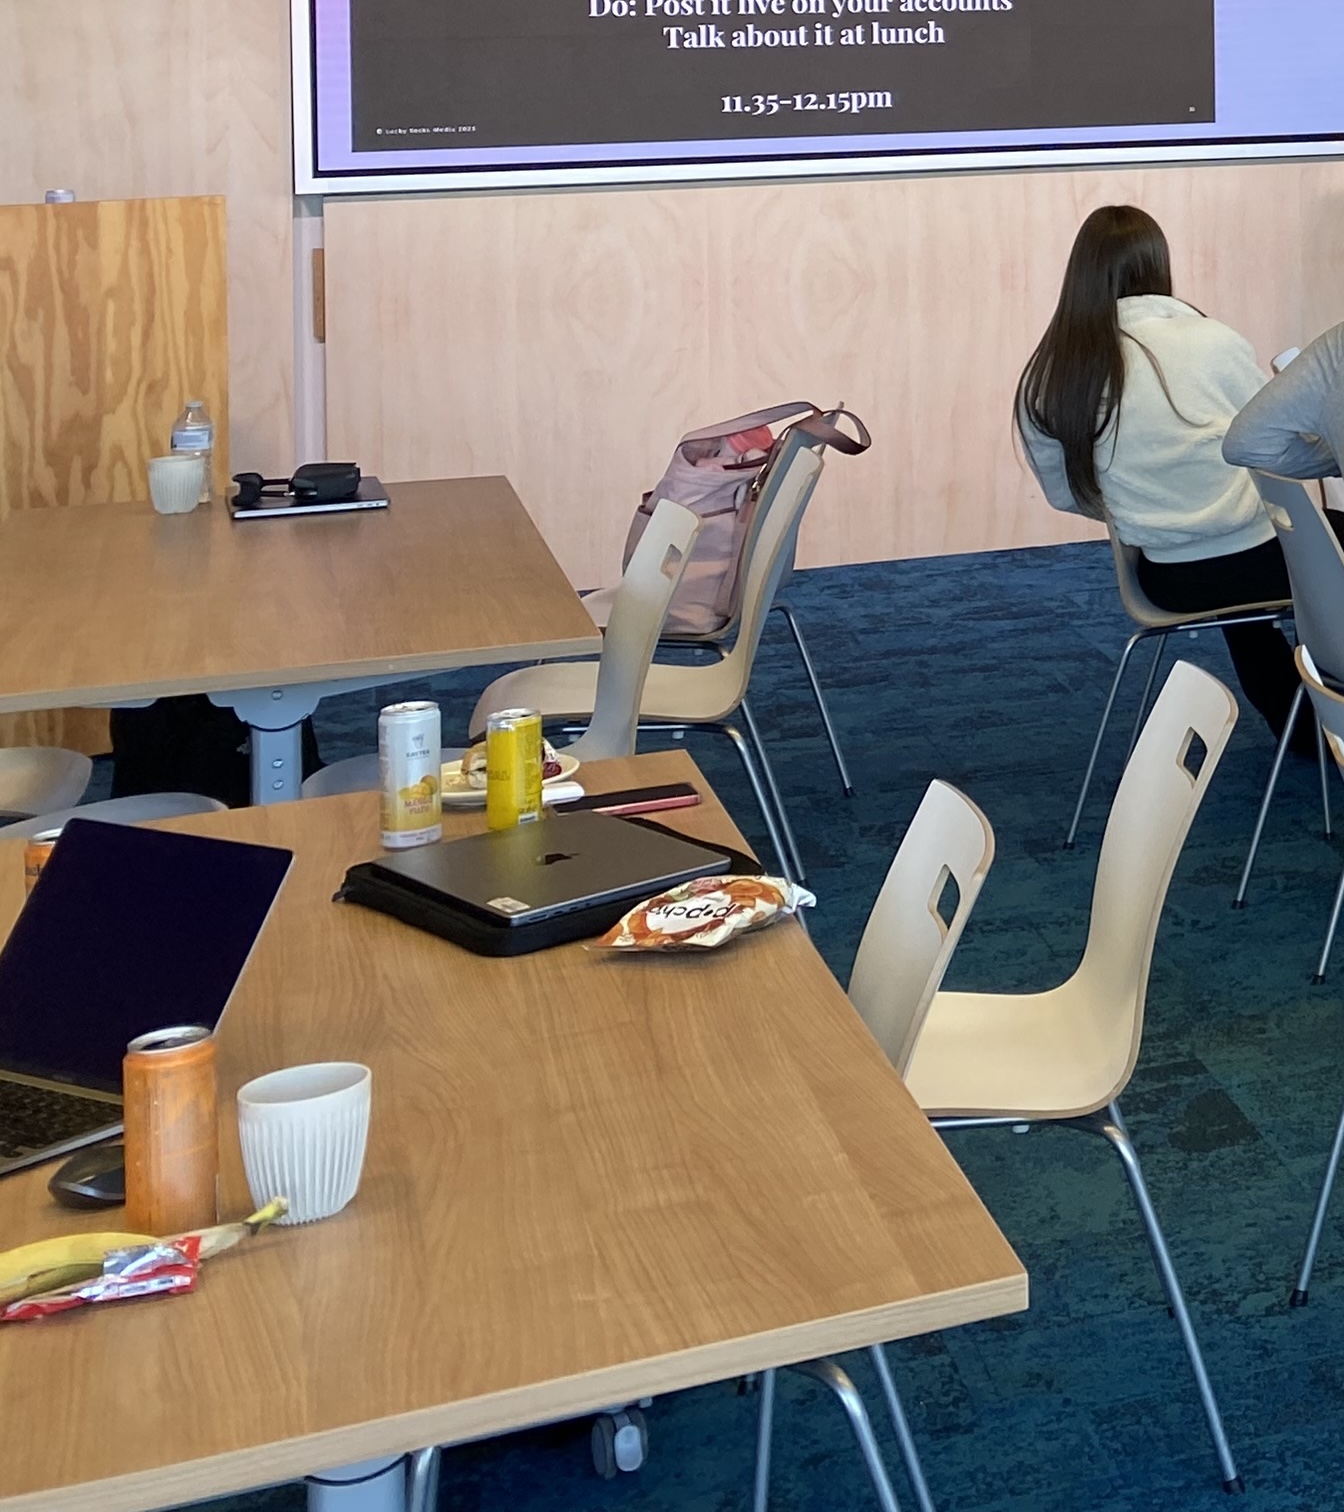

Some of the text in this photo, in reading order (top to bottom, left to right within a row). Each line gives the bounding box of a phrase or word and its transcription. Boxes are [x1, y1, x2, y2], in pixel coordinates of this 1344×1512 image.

[662, 20, 946, 49] Talk about it at lunch
[721, 91, 893, 116] 11.35-12.15pm
